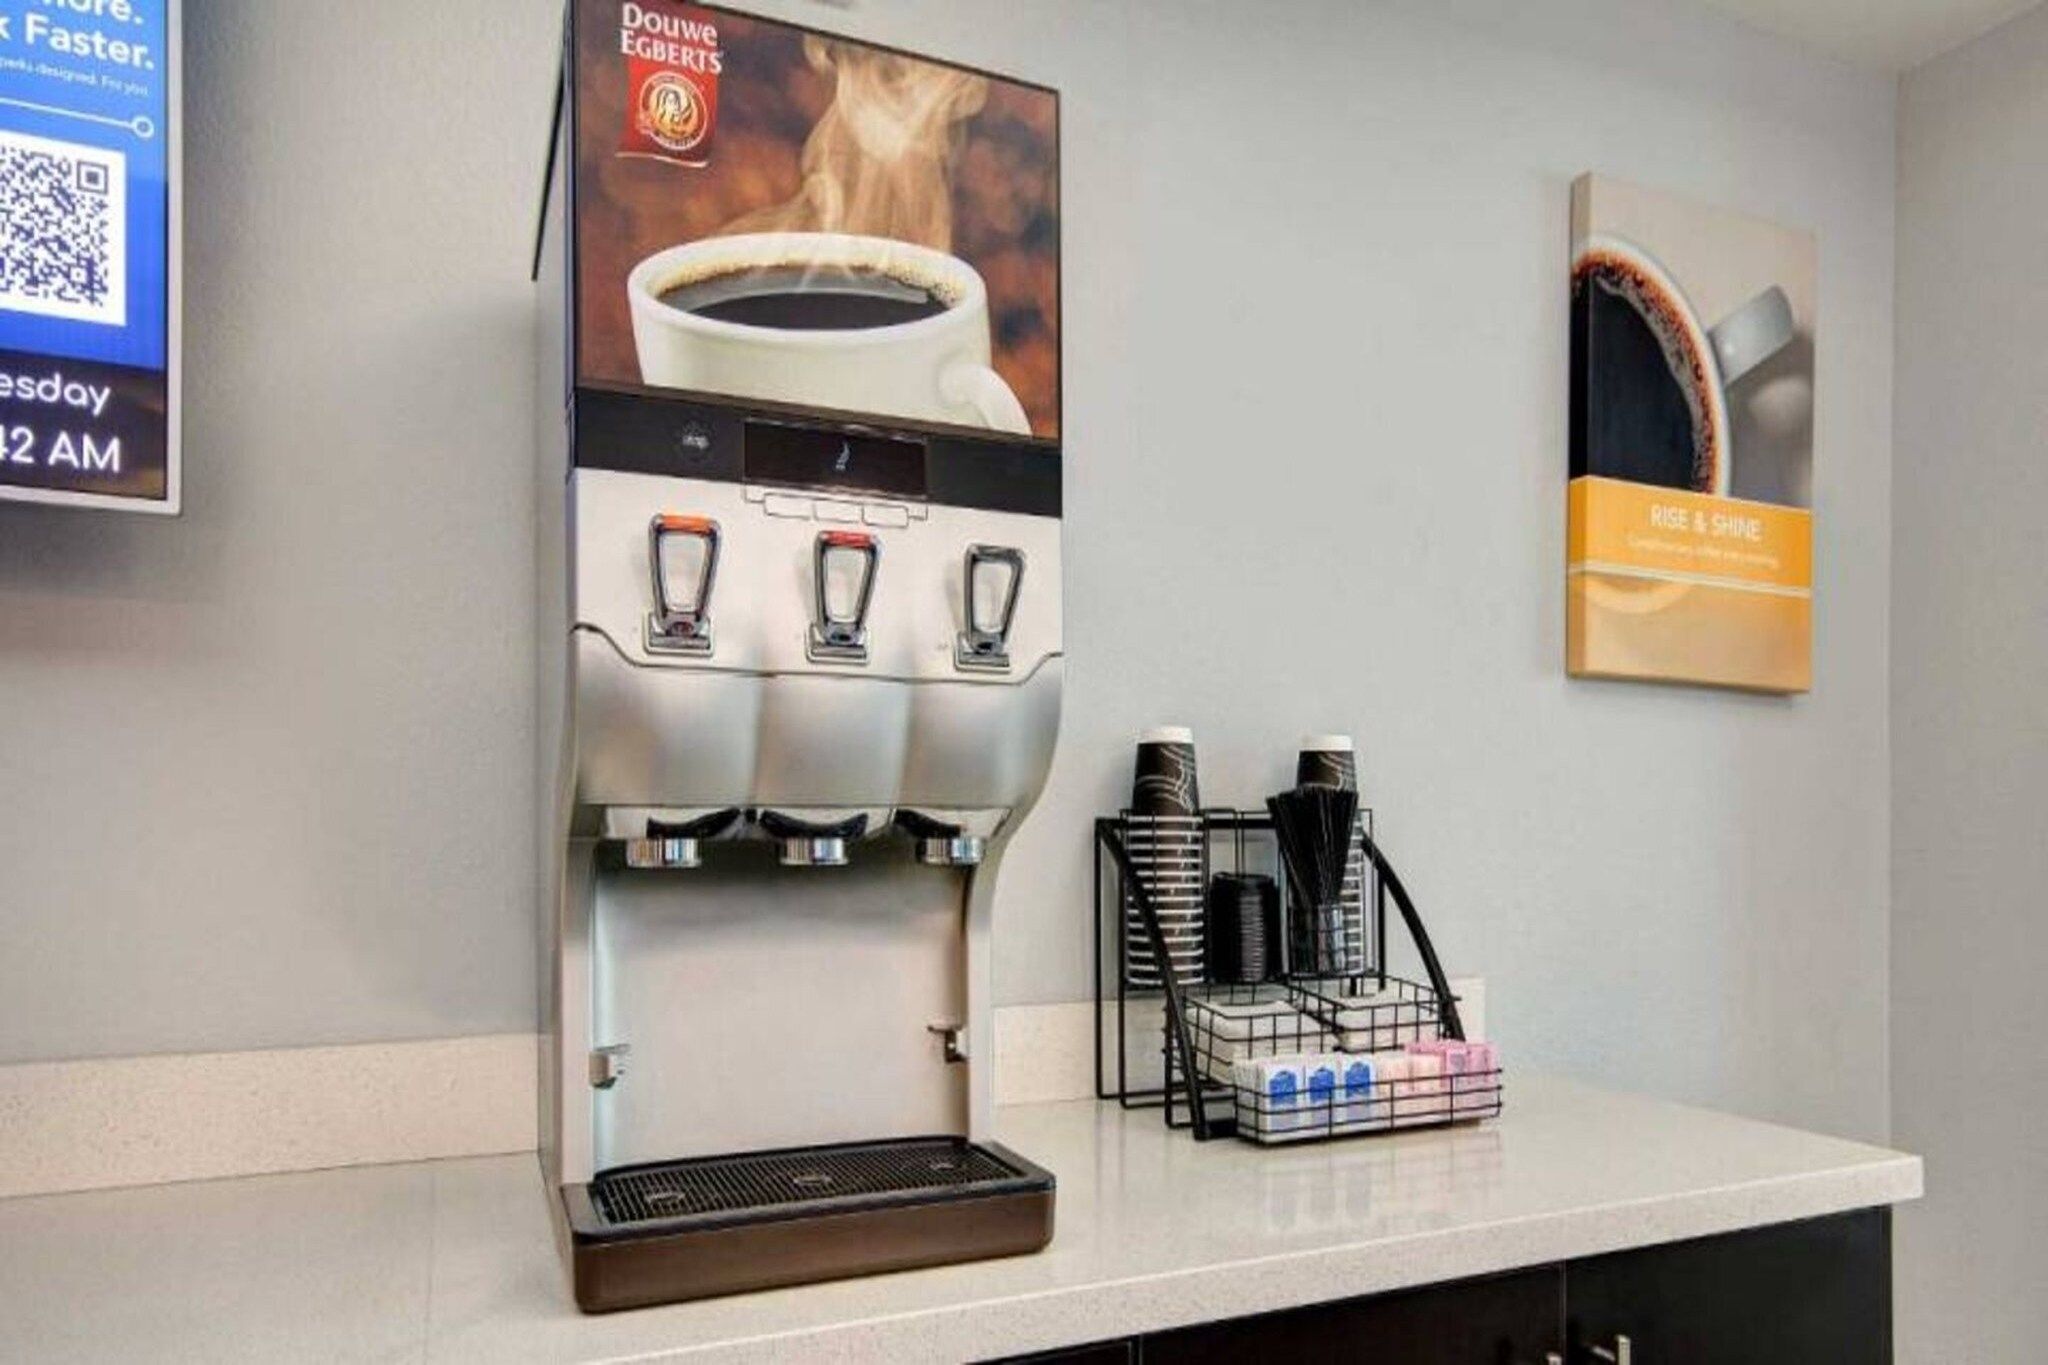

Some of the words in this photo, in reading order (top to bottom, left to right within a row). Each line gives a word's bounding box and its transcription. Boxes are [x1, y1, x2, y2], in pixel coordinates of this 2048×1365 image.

[25, 12, 155, 70] Faster.
[0, 372, 111, 417] esday
[48, 430, 120, 472] AM
[1650, 504, 1688, 529] RISE
[1694, 511, 1708, 533] &
[1712, 511, 1764, 542] SHINE
